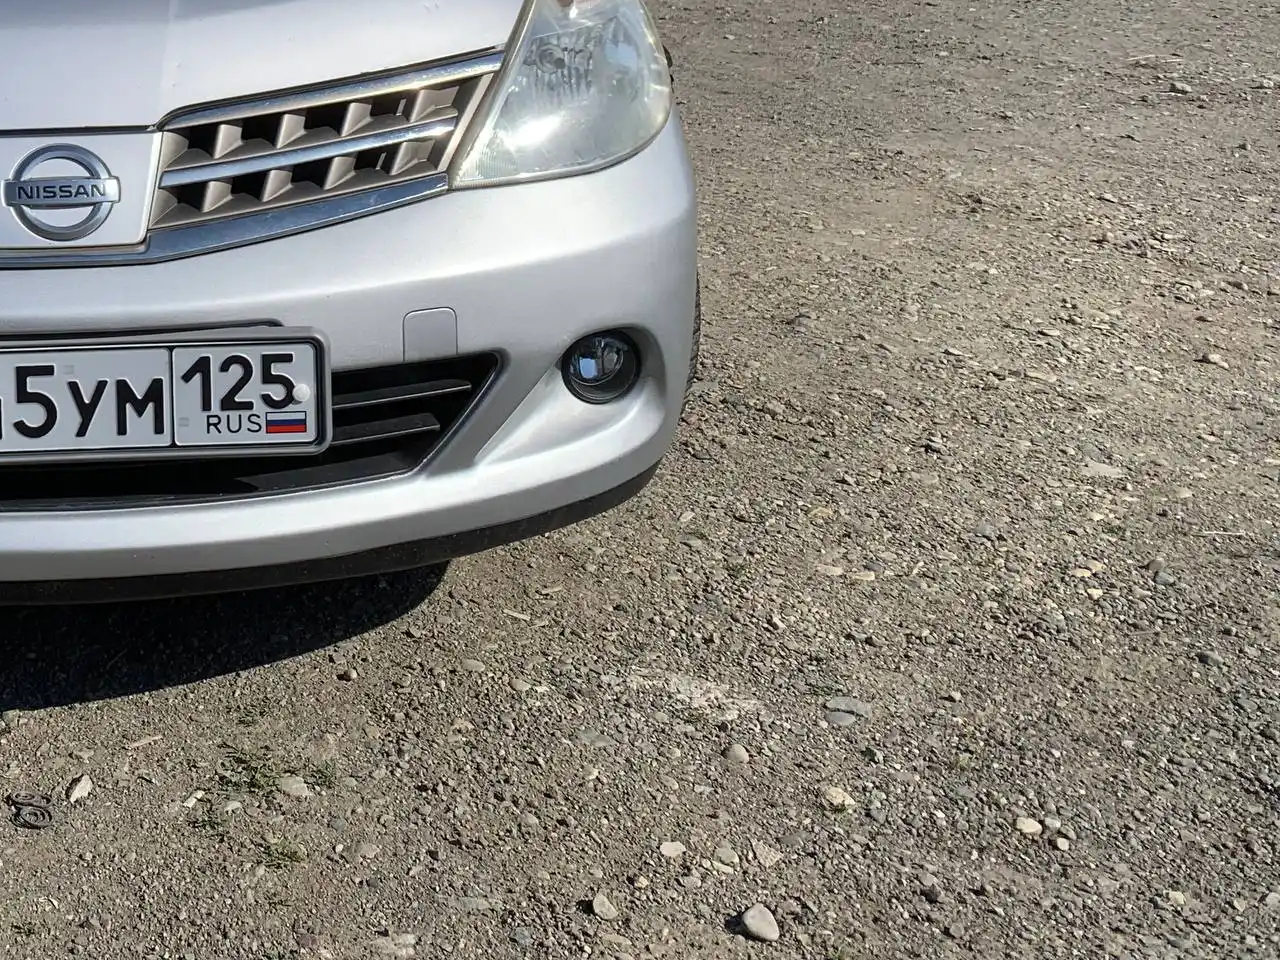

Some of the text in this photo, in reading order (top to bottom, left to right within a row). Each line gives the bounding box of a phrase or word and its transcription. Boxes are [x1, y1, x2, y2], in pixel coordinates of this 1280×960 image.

[17, 183, 107, 200] NISSAN
[180, 352, 296, 412] 125
[206, 413, 263, 435] RUS
